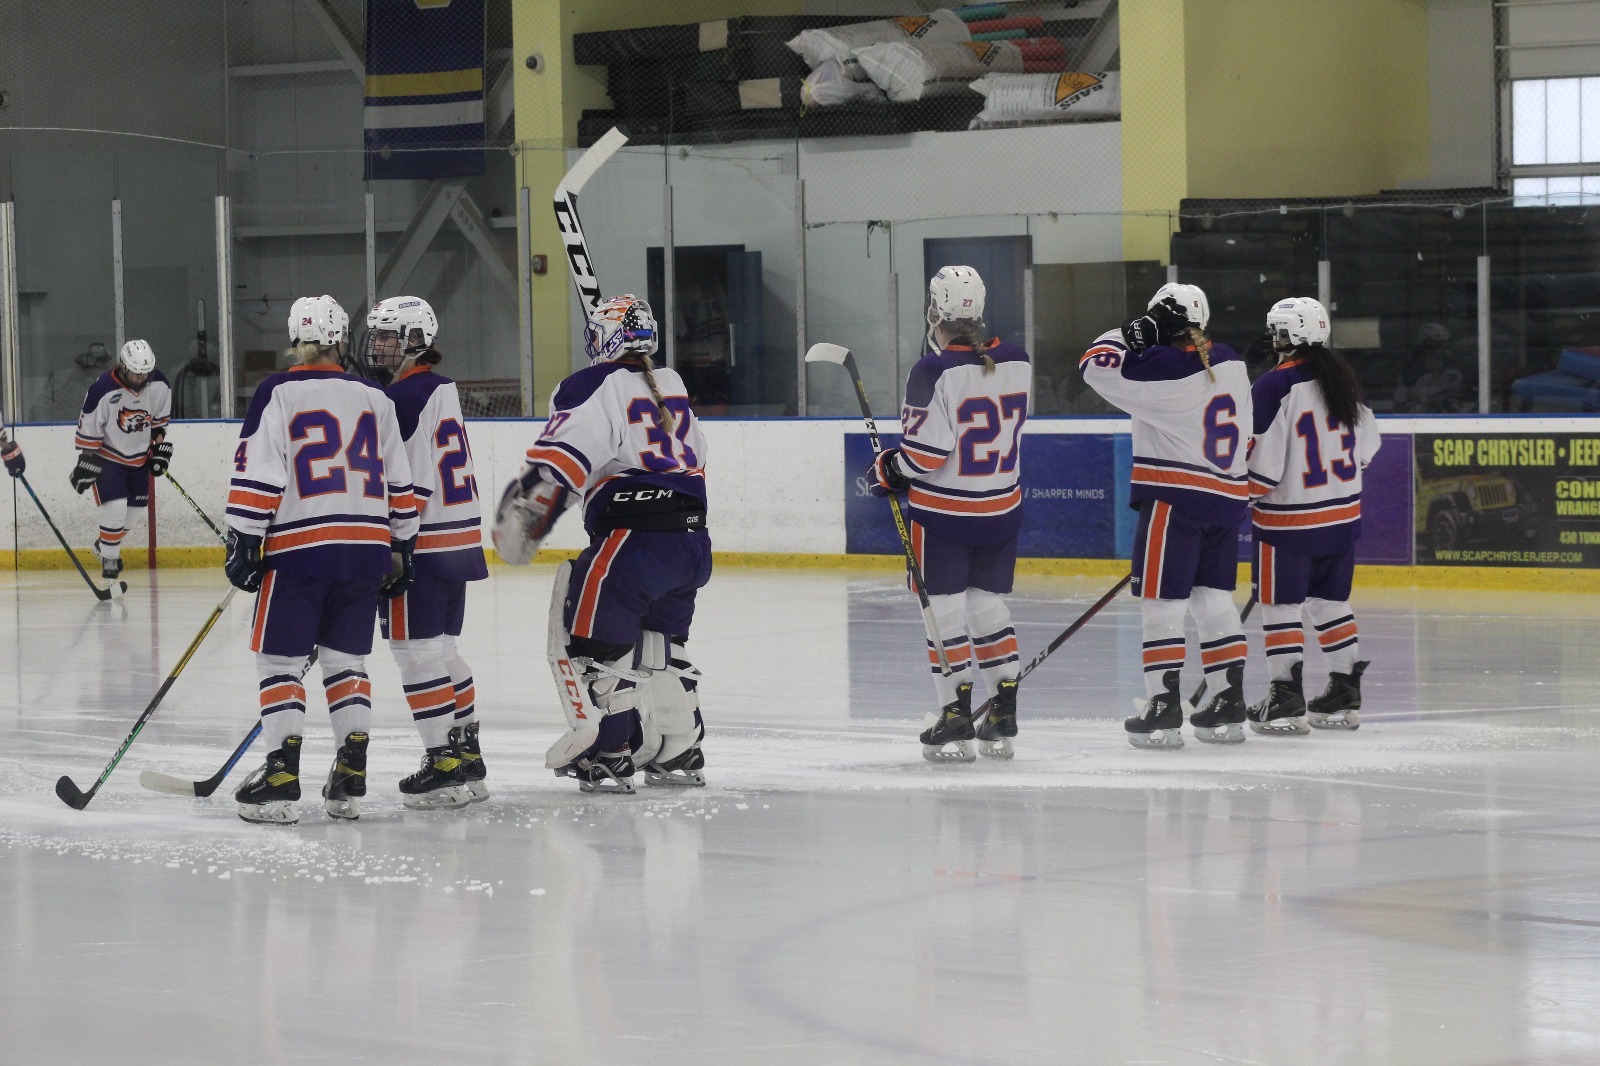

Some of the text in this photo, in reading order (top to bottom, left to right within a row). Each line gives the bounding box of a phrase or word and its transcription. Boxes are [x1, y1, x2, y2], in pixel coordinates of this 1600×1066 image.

[302, 317, 312, 326] 24
[962, 298, 973, 307] 27
[627, 395, 698, 473] 37
[901, 406, 929, 437] 27
[957, 391, 1028, 477] 27
[1202, 392, 1240, 471] 6
[288, 408, 385, 500] 24
[435, 417, 480, 507] 2
[1295, 410, 1357, 489] 13
[1433, 439, 1600, 466] SCAP CHRYSLER JEEP
[613, 489, 674, 502] CCM
[1031, 488, 1073, 499] SHARPER
[1075, 489, 1105, 500] MINDS
[1435, 550, 1583, 563] WWW.SCAPCHRYSLERJEEP.COM
[557, 658, 588, 720] CCM
